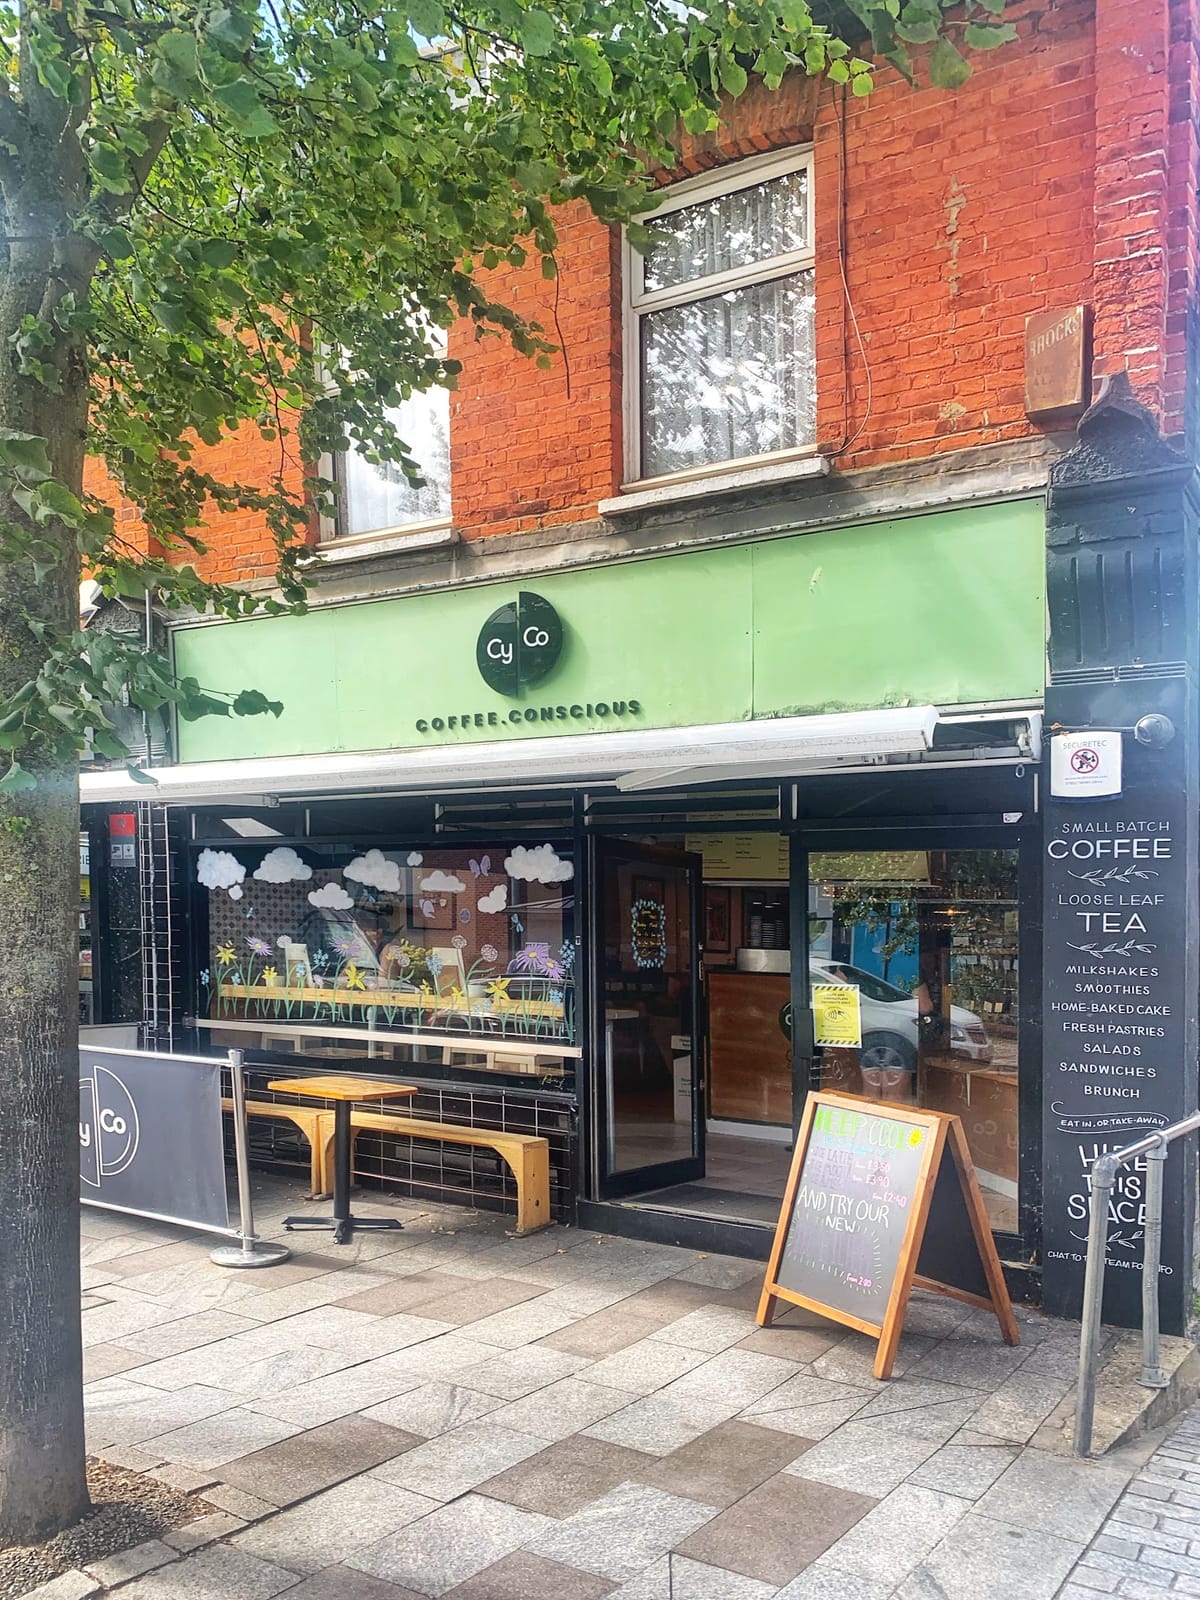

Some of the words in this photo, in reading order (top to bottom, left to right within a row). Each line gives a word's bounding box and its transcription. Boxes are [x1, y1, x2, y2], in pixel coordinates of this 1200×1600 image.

[487, 638, 513, 664] Cy
[523, 626, 549, 647] Co
[1063, 740, 1108, 750] SECURETEC
[1062, 822, 1112, 834] SMALL
[1116, 821, 1170, 833] BATCH
[1047, 838, 1172, 859] COFFEE
[1058, 894, 1114, 906] LOOSE
[1119, 894, 1165, 906] LEAF
[1076, 912, 1147, 933] TEA
[1065, 965, 1159, 977] MILKSHAKES
[1074, 983, 1151, 995] SMOOTHIES
[1051, 1002, 1134, 1014] HOME-BAKED
[1136, 1005, 1171, 1016] CAKE
[1063, 1022, 1105, 1034] FRESH
[1108, 1024, 1165, 1037] PASTRIES
[1083, 1043, 1141, 1056] SALADS
[1059, 1062, 1157, 1078] SANDWICHES
[1084, 1085, 1140, 1099] BRUNCH
[100, 1108, 127, 1135] Co
[1060, 1119, 1080, 1128] EAT
[1097, 1119, 1110, 1127] OR
[1110, 1116, 1165, 1127] TAKE-AWAY
[1081, 1174, 1142, 1200] TIS
[797, 1184, 827, 1211] AND
[829, 1193, 855, 1216] TRY
[855, 1199, 889, 1229] OUR
[1067, 1194, 1148, 1225] SACE
[825, 1215, 856, 1233] NEW
[1047, 1250, 1070, 1260] CHAT
[1070, 1253, 1082, 1262] TO
[1103, 1257, 1131, 1269] TEAM
[1131, 1262, 1144, 1271] FO
